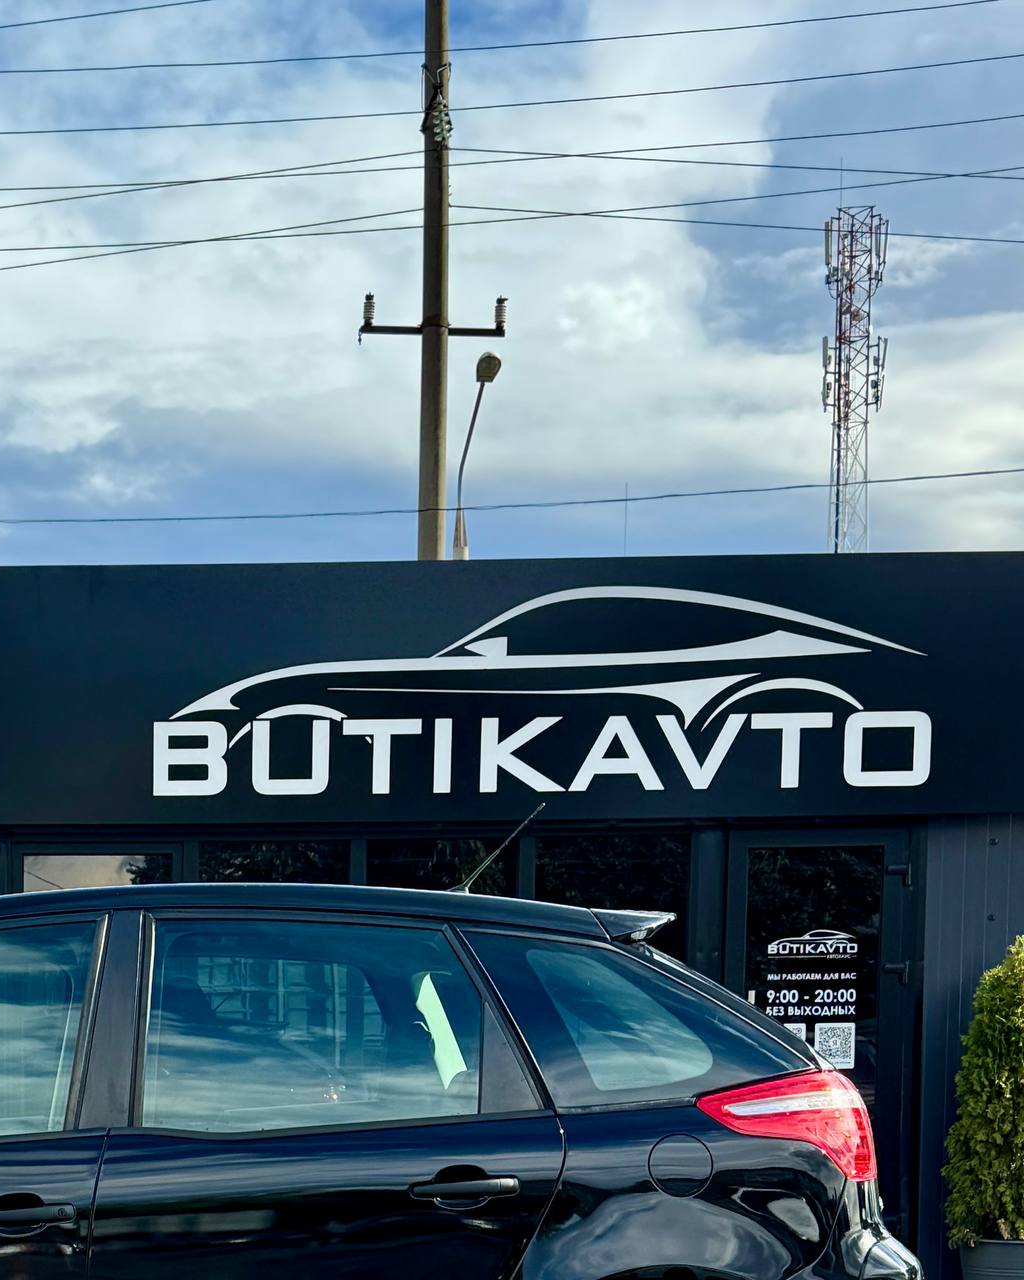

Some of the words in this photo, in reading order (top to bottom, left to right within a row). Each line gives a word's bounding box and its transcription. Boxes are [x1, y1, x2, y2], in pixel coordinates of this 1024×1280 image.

[152, 710, 932, 797] BUTIKAVTO
[767, 943, 858, 954] BUTIKAVTO
[766, 990, 799, 1003] 9:00
[814, 989, 856, 1002] 20:00
[766, 1006, 784, 1016] БЕЗ
[787, 1005, 856, 1016] ВЫХОДНЫХ
